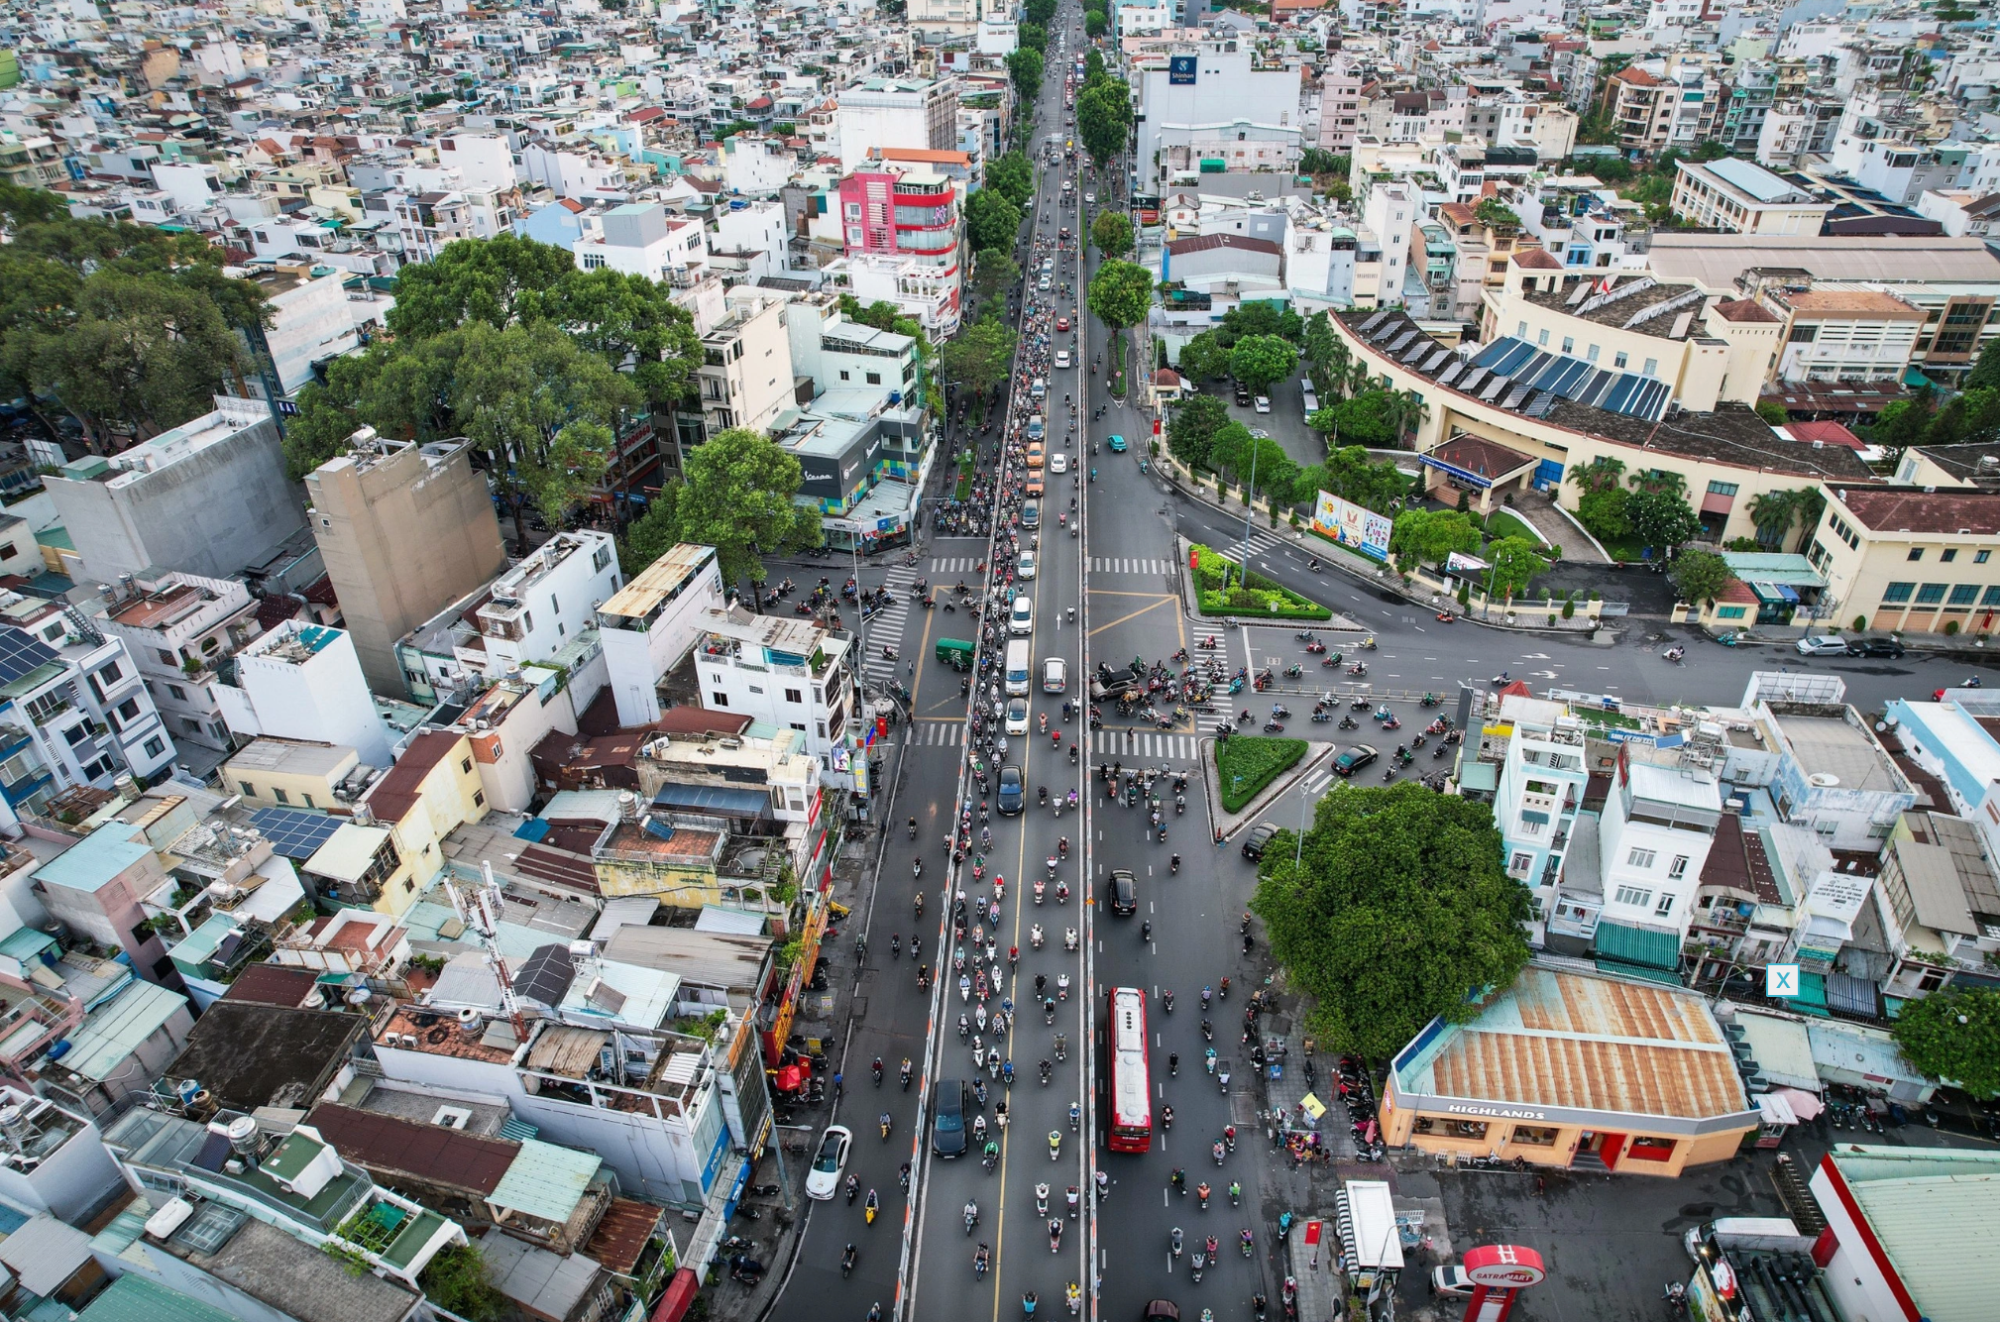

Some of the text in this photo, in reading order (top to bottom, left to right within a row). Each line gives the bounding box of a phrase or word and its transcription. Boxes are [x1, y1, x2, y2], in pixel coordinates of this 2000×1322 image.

[804, 470, 832, 481] Vespa
[1448, 1104, 1545, 1120] HIGHLANDS
[1476, 1272, 1530, 1282] SATRAMART
